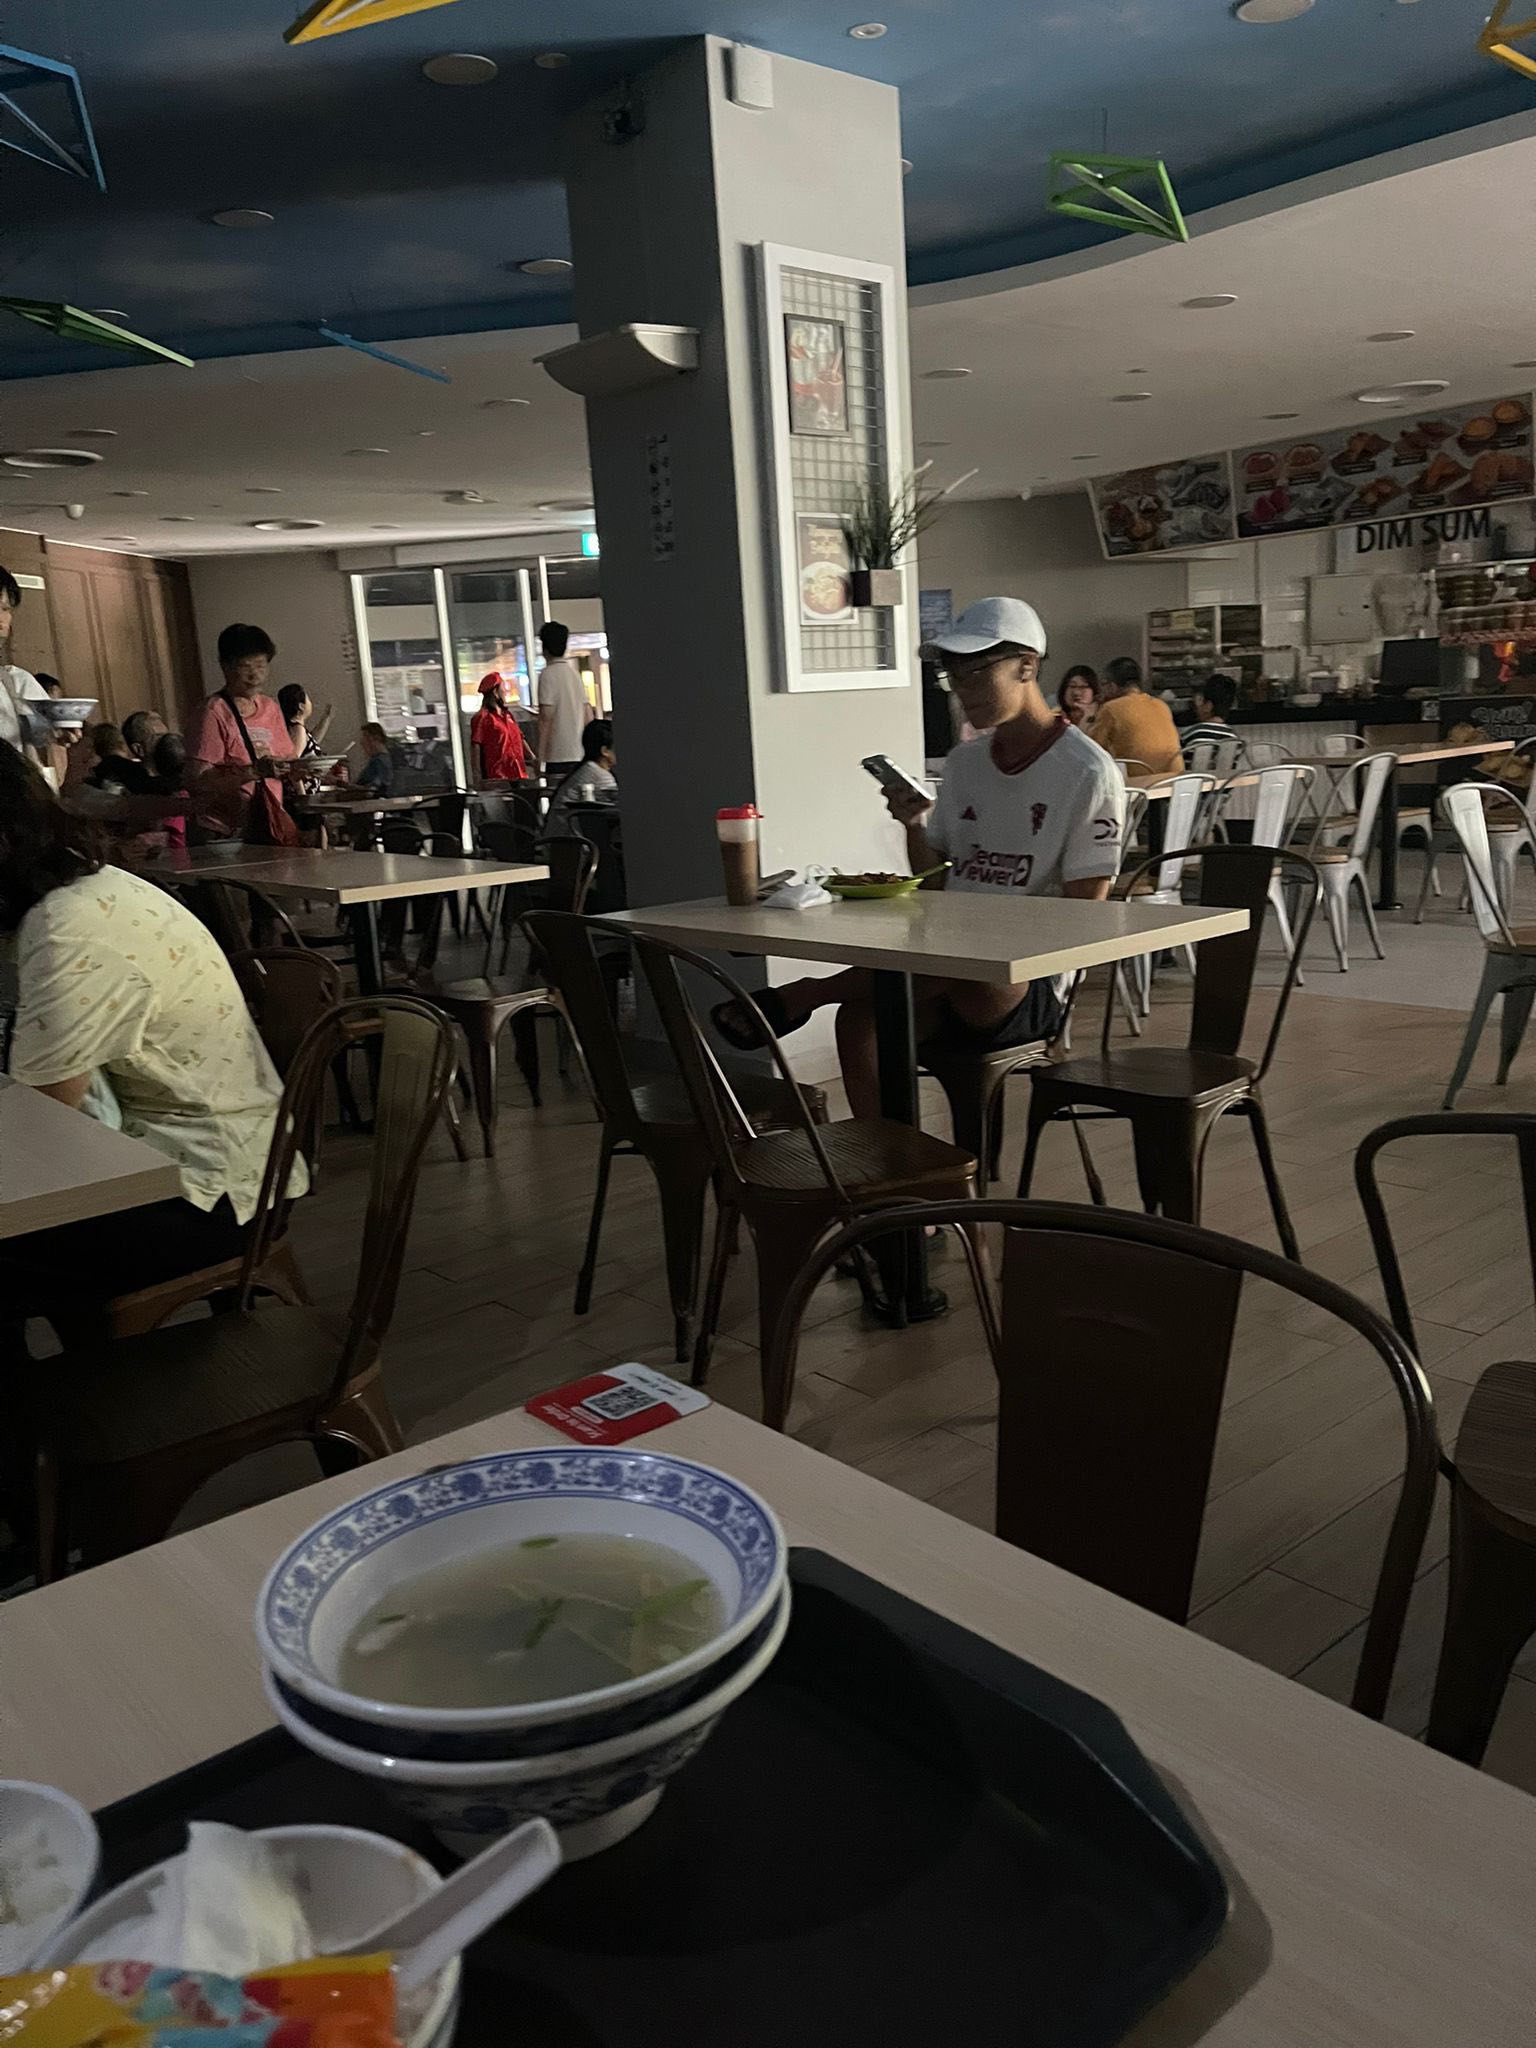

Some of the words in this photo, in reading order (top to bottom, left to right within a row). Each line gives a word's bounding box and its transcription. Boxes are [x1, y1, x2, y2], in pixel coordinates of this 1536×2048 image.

[1355, 519, 1413, 553] DIM
[1421, 508, 1491, 545] SUM
[952, 857, 1013, 885] Vewer
